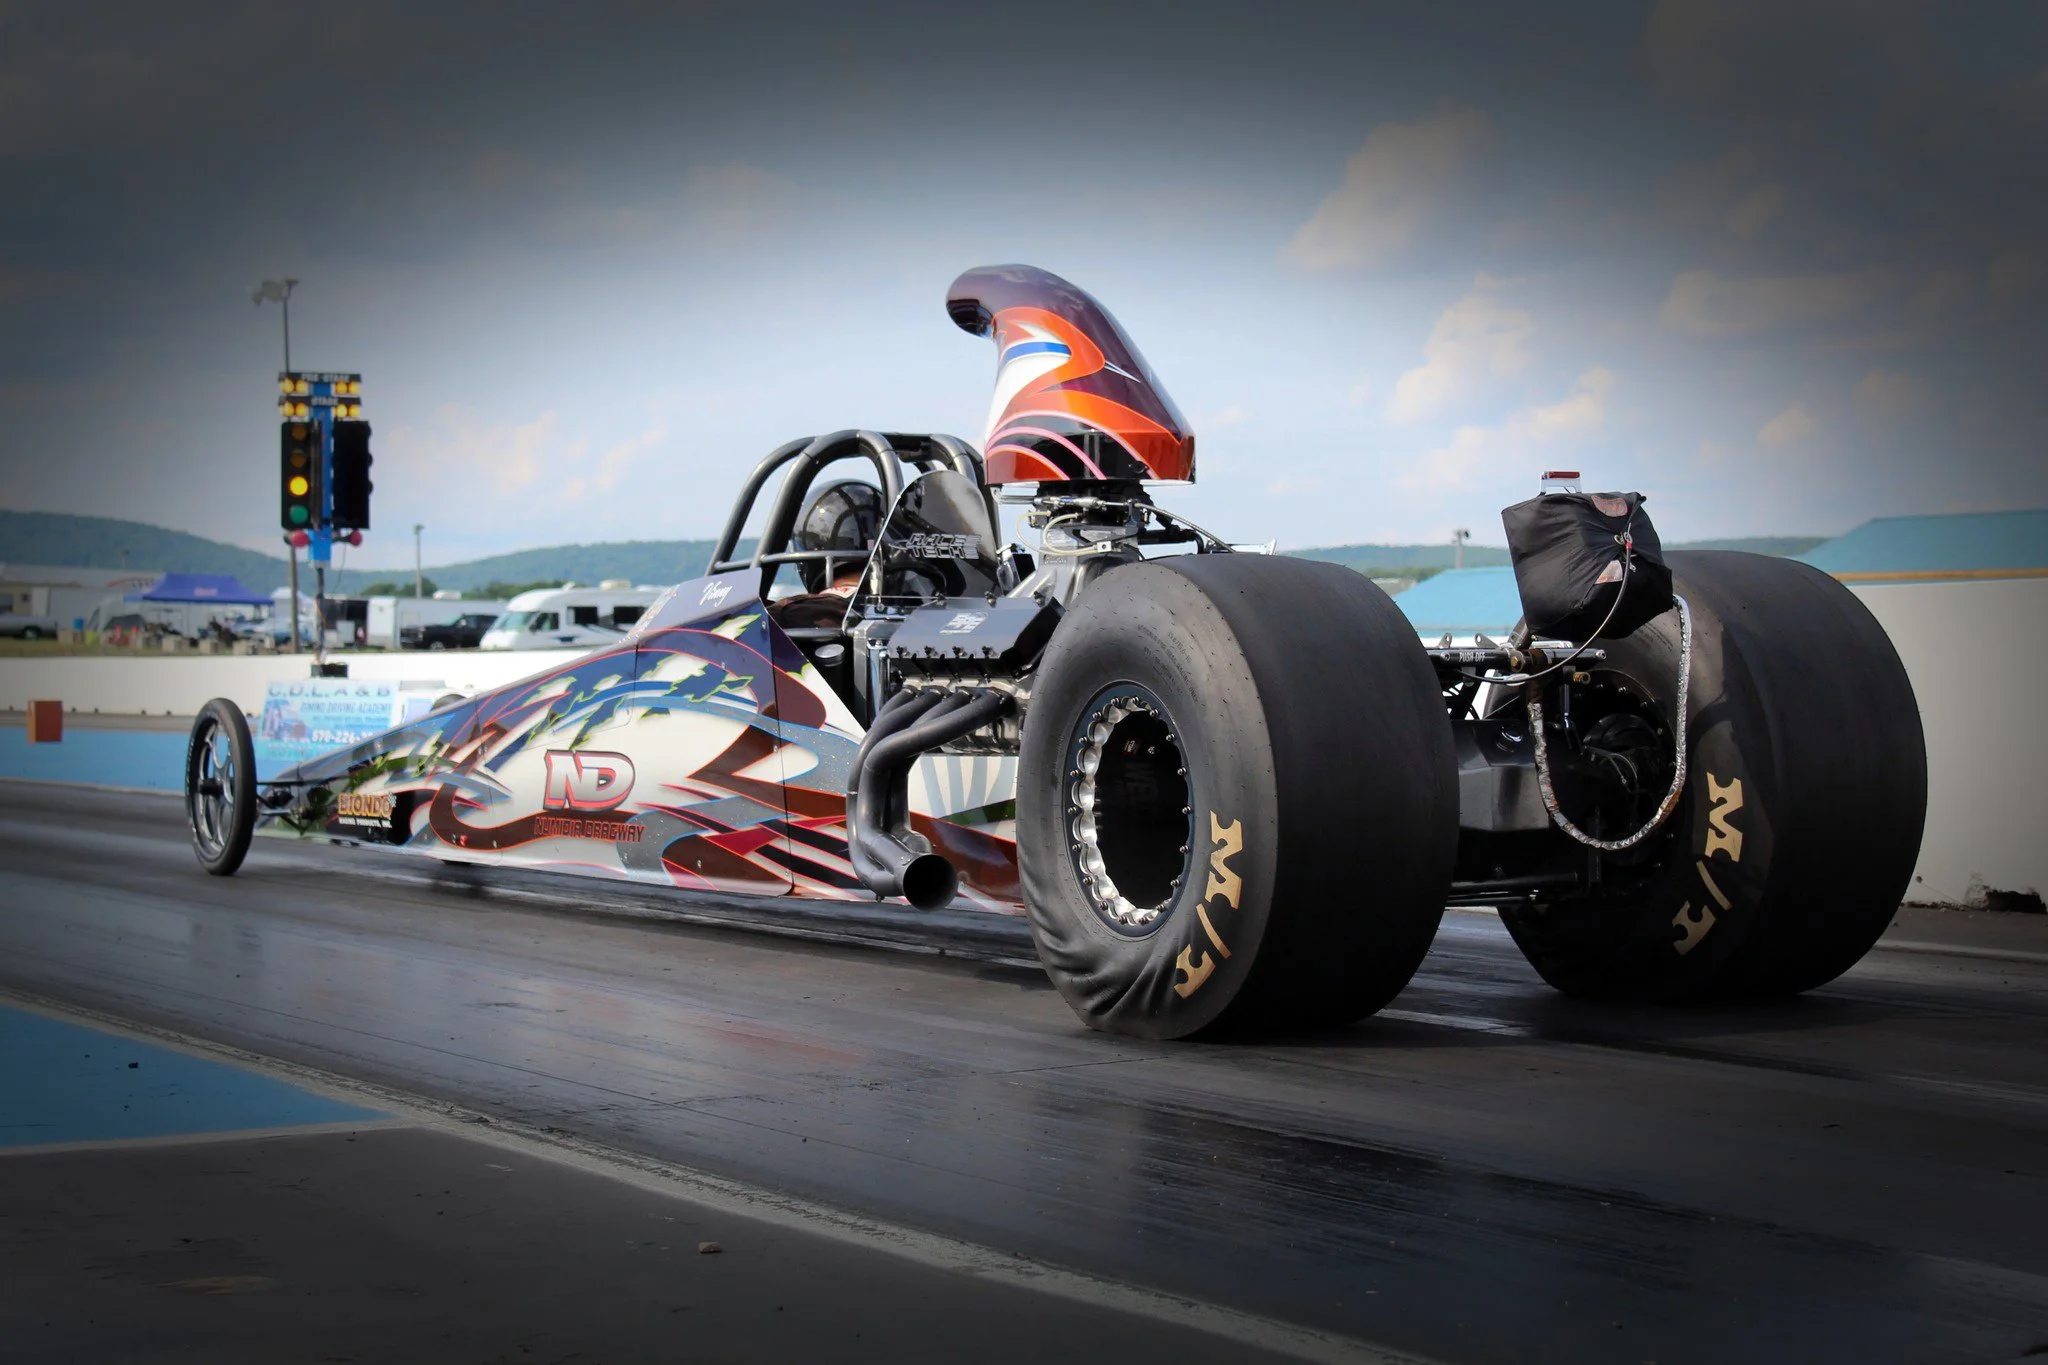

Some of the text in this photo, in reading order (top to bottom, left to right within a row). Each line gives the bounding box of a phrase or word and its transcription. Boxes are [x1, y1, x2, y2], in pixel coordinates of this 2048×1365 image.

[338, 793, 392, 818] BIONDO
[543, 749, 636, 813] ND
[535, 816, 645, 842] NUMIDIA DRAGWAY
[1672, 772, 1743, 956] M/T
[1174, 810, 1243, 999] M/T
